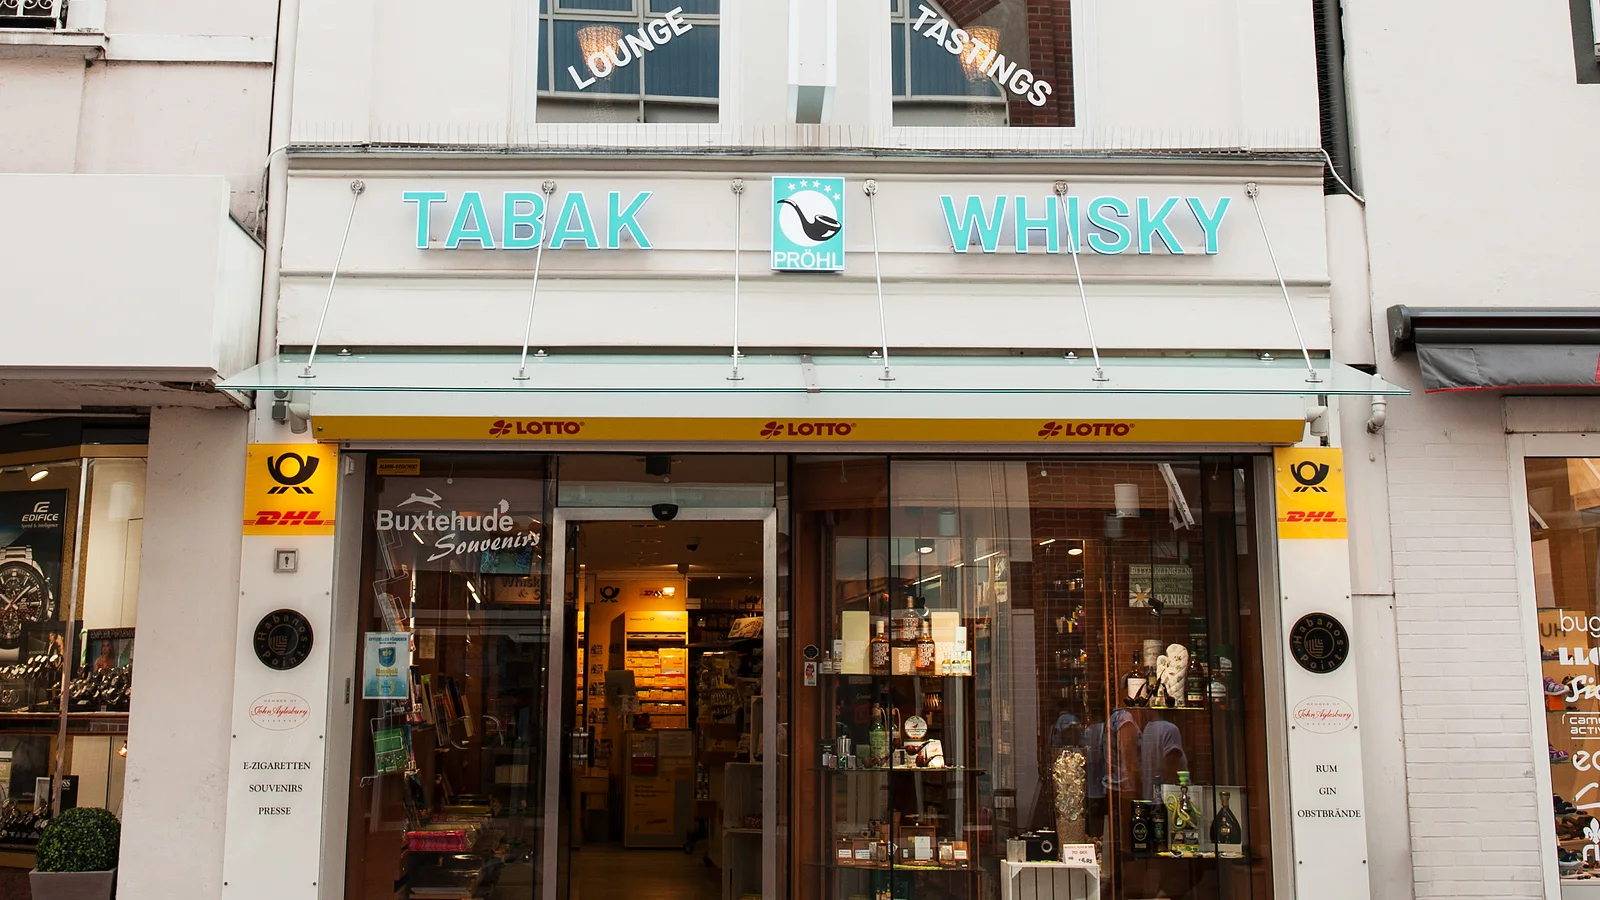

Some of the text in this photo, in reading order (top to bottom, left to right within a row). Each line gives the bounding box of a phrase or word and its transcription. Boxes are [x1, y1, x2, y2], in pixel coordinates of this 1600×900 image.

[567, 6, 693, 90] LOUNGE
[912, 4, 1053, 107] TASTINGS
[402, 191, 653, 250] TABAK
[939, 195, 1232, 255] WHISKY
[774, 248, 843, 268] PRÖHL
[22, 514, 59, 522] EDIFICE
[254, 510, 325, 526] DHL
[376, 508, 514, 532] Buxtehude
[1286, 510, 1340, 522] DHL
[426, 531, 541, 562] Souvenirs
[1130, 567, 1151, 575] BITTE
[257, 614, 308, 642] Habanos
[1294, 618, 1343, 645] Habanos
[262, 650, 304, 666] Point
[1300, 654, 1342, 670] Point
[251, 706, 271, 716] John
[1295, 709, 1315, 719] John
[243, 762, 311, 770] E-ZIGARETTEN
[249, 784, 303, 792] SOUVENIRS
[258, 807, 291, 815] PRESSE
[1297, 808, 1361, 818] OBSTBRÄNDE
